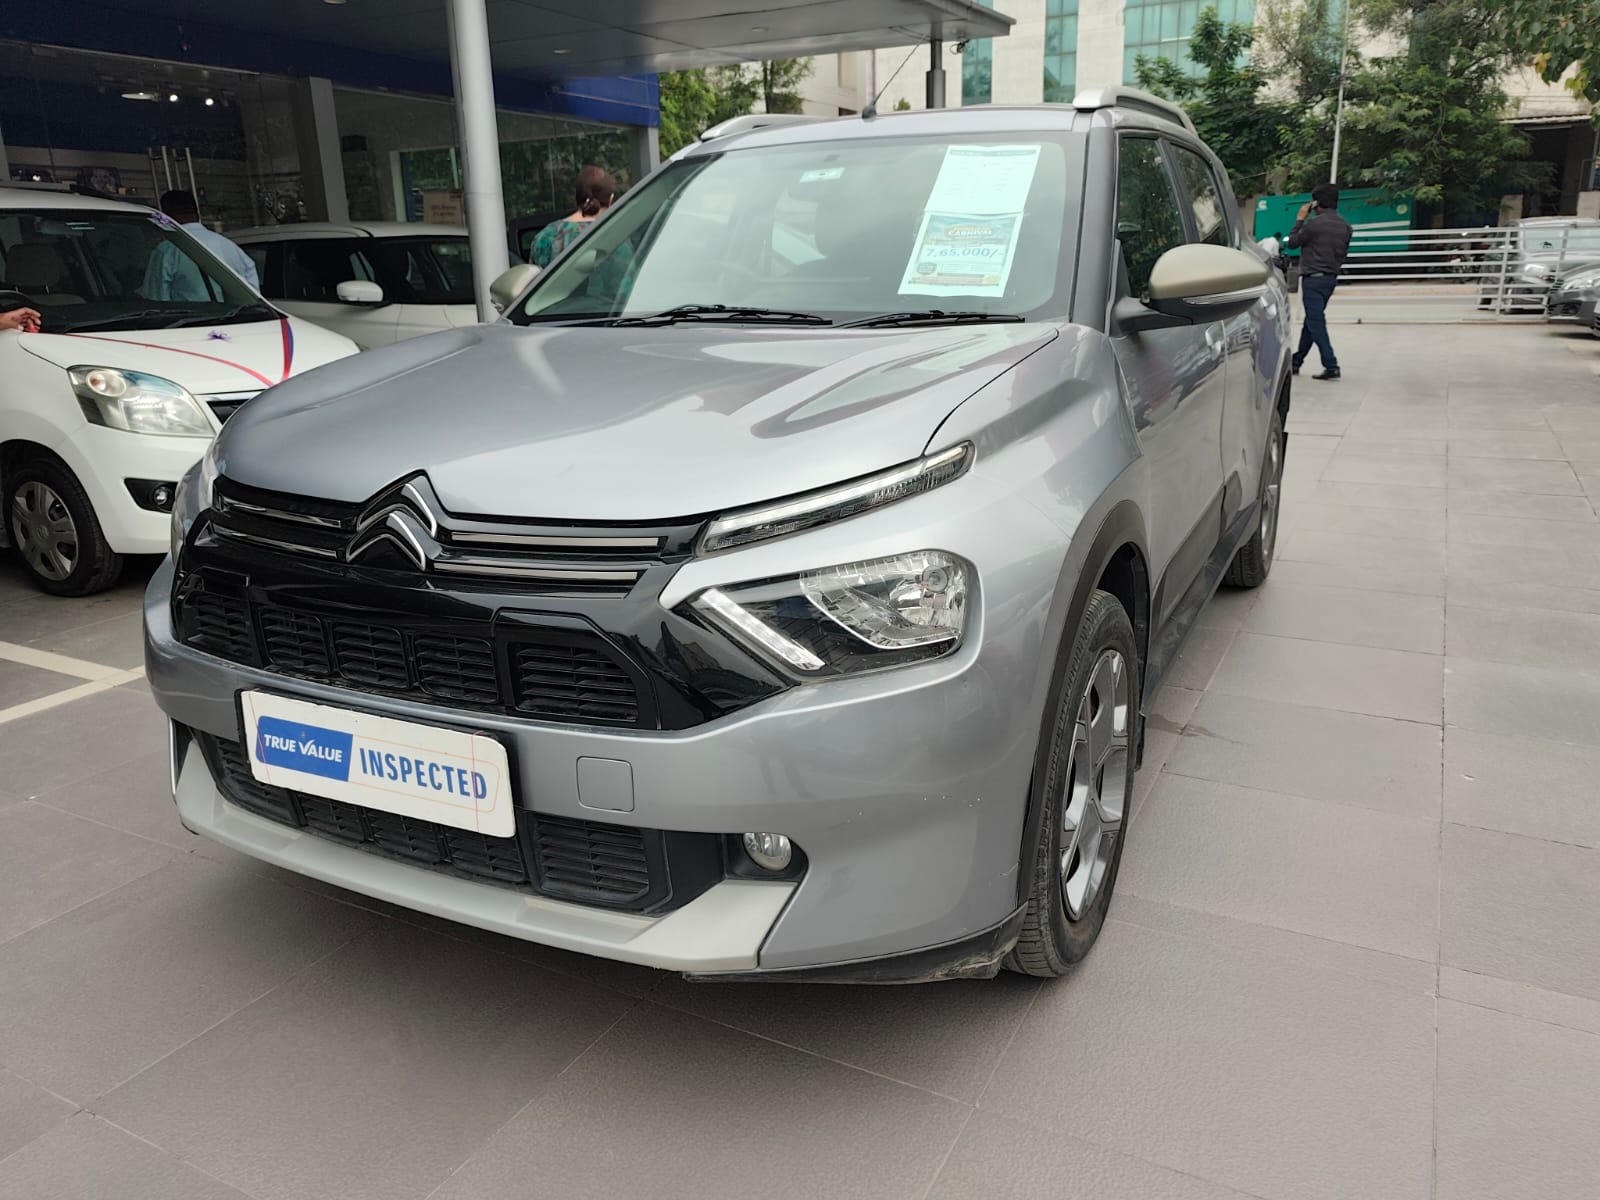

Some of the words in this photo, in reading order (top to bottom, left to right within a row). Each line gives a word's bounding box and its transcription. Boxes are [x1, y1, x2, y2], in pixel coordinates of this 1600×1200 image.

[264, 734, 296, 753] TRUE
[298, 739, 343, 763] VALUE
[359, 748, 487, 799] INSPECTED
